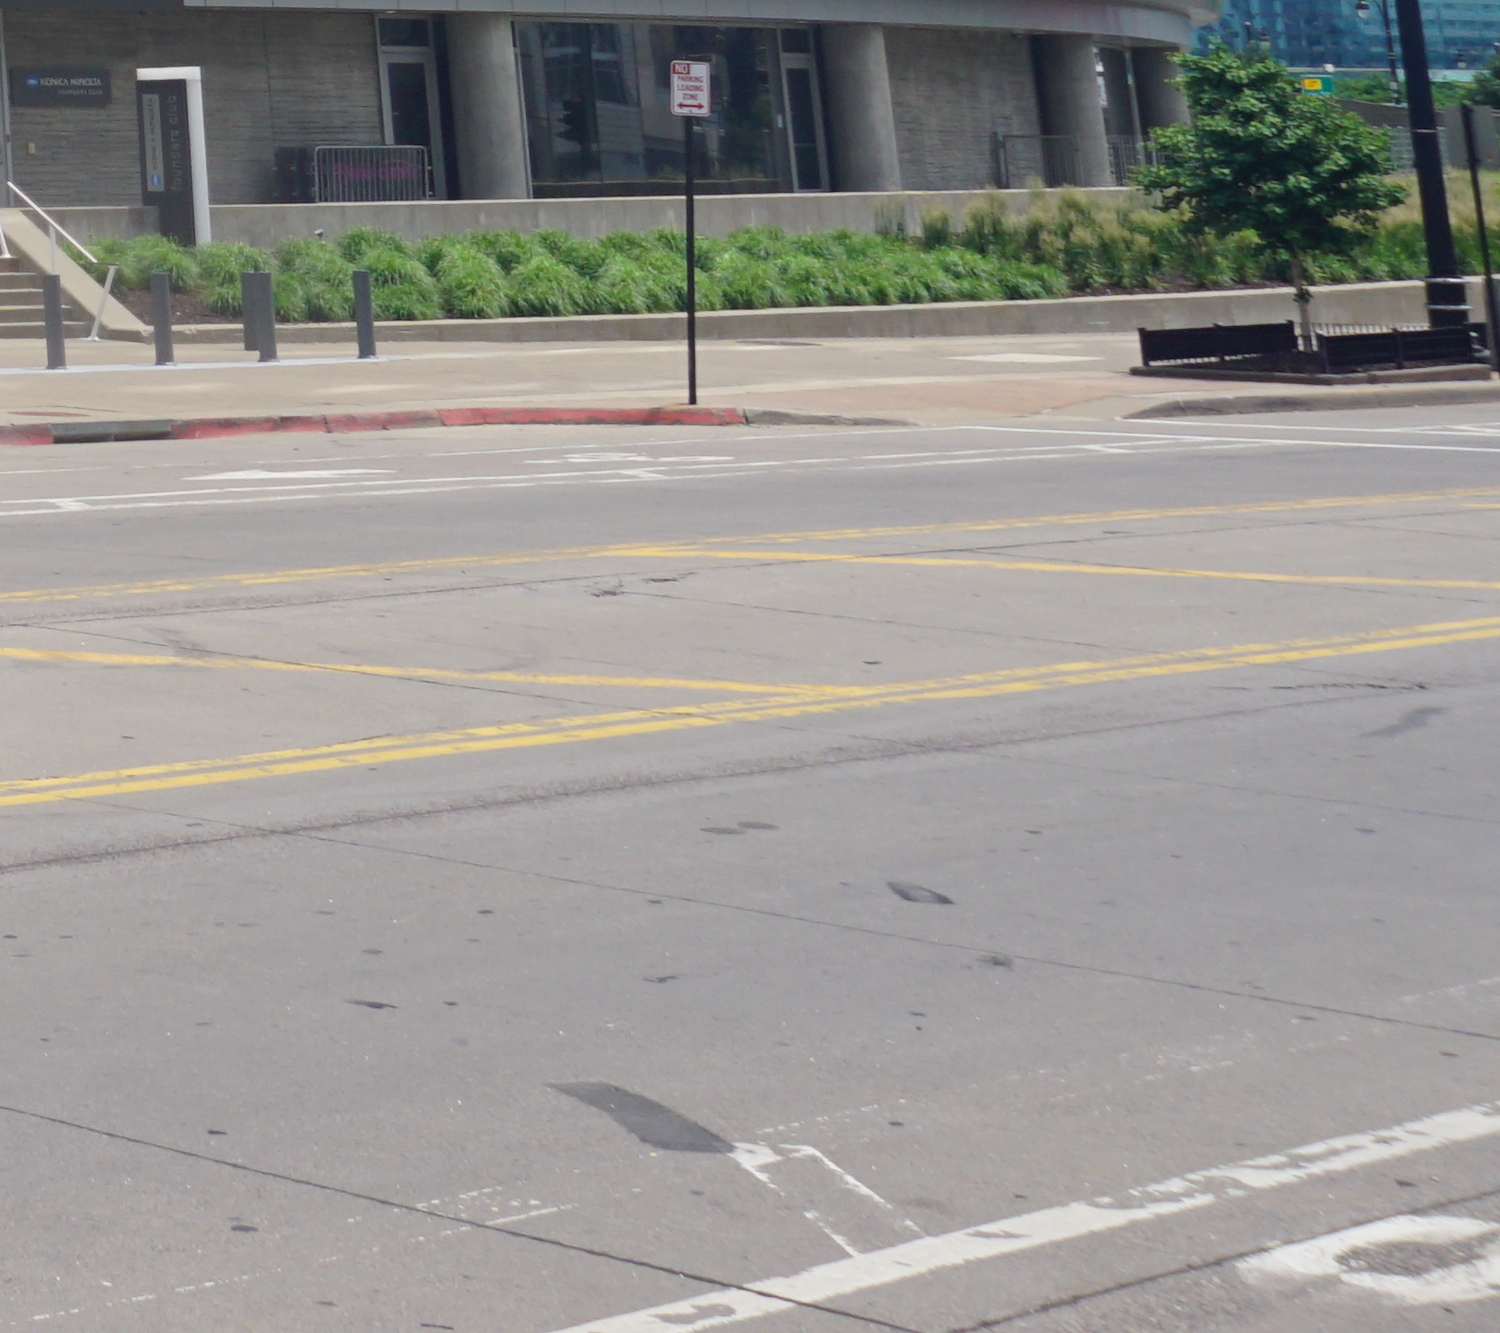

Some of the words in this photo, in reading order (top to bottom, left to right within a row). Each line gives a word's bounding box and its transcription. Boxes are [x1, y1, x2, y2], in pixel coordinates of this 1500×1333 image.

[675, 63, 689, 74] NO
[40, 77, 69, 87] KONICA
[69, 77, 103, 87] MINOLTA
[677, 75, 704, 83] PARKING
[677, 84, 704, 92] LOADING
